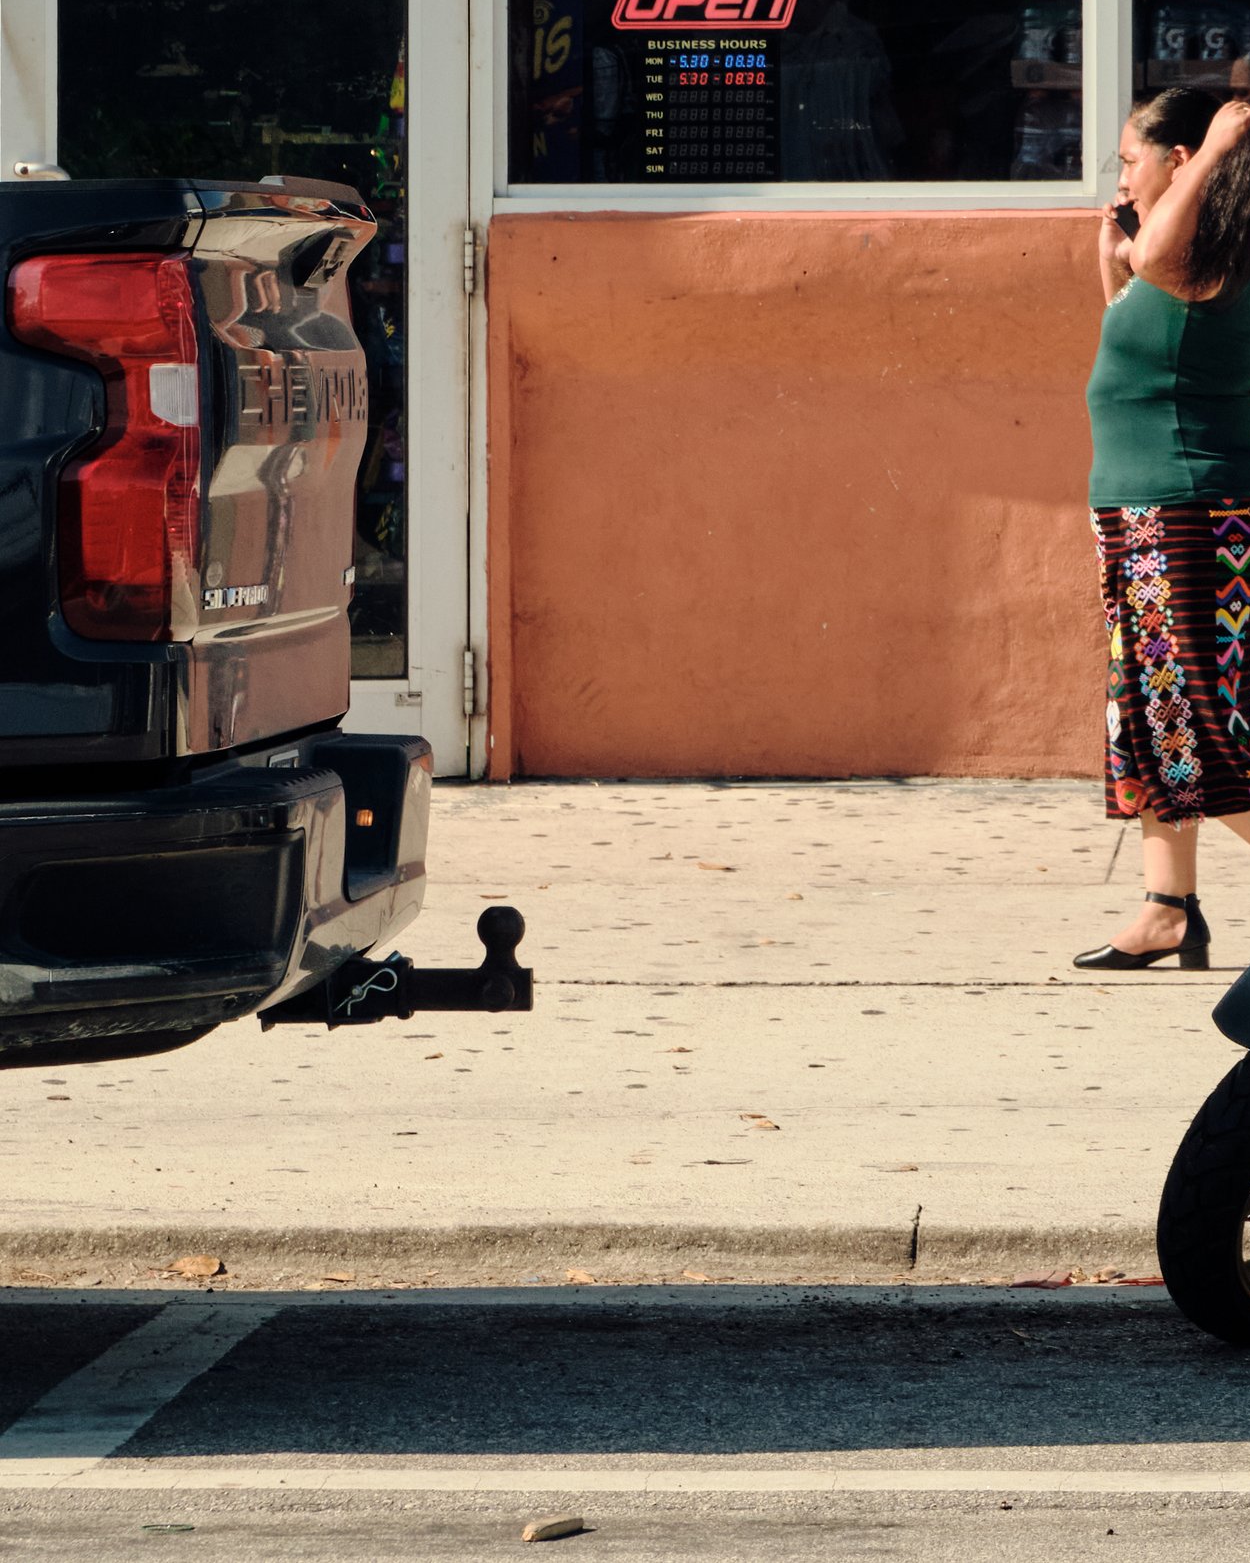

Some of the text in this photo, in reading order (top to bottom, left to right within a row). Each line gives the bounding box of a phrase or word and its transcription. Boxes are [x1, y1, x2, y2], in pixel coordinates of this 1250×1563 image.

[647, 39, 767, 50] BUSINESS HOURS
[645, 93, 663, 101] WED
[646, 111, 663, 119] THU
[645, 129, 663, 137] FRI
[646, 147, 663, 155] SAT
[646, 165, 664, 173] SUN
[239, 364, 367, 426] CHEVROLE
